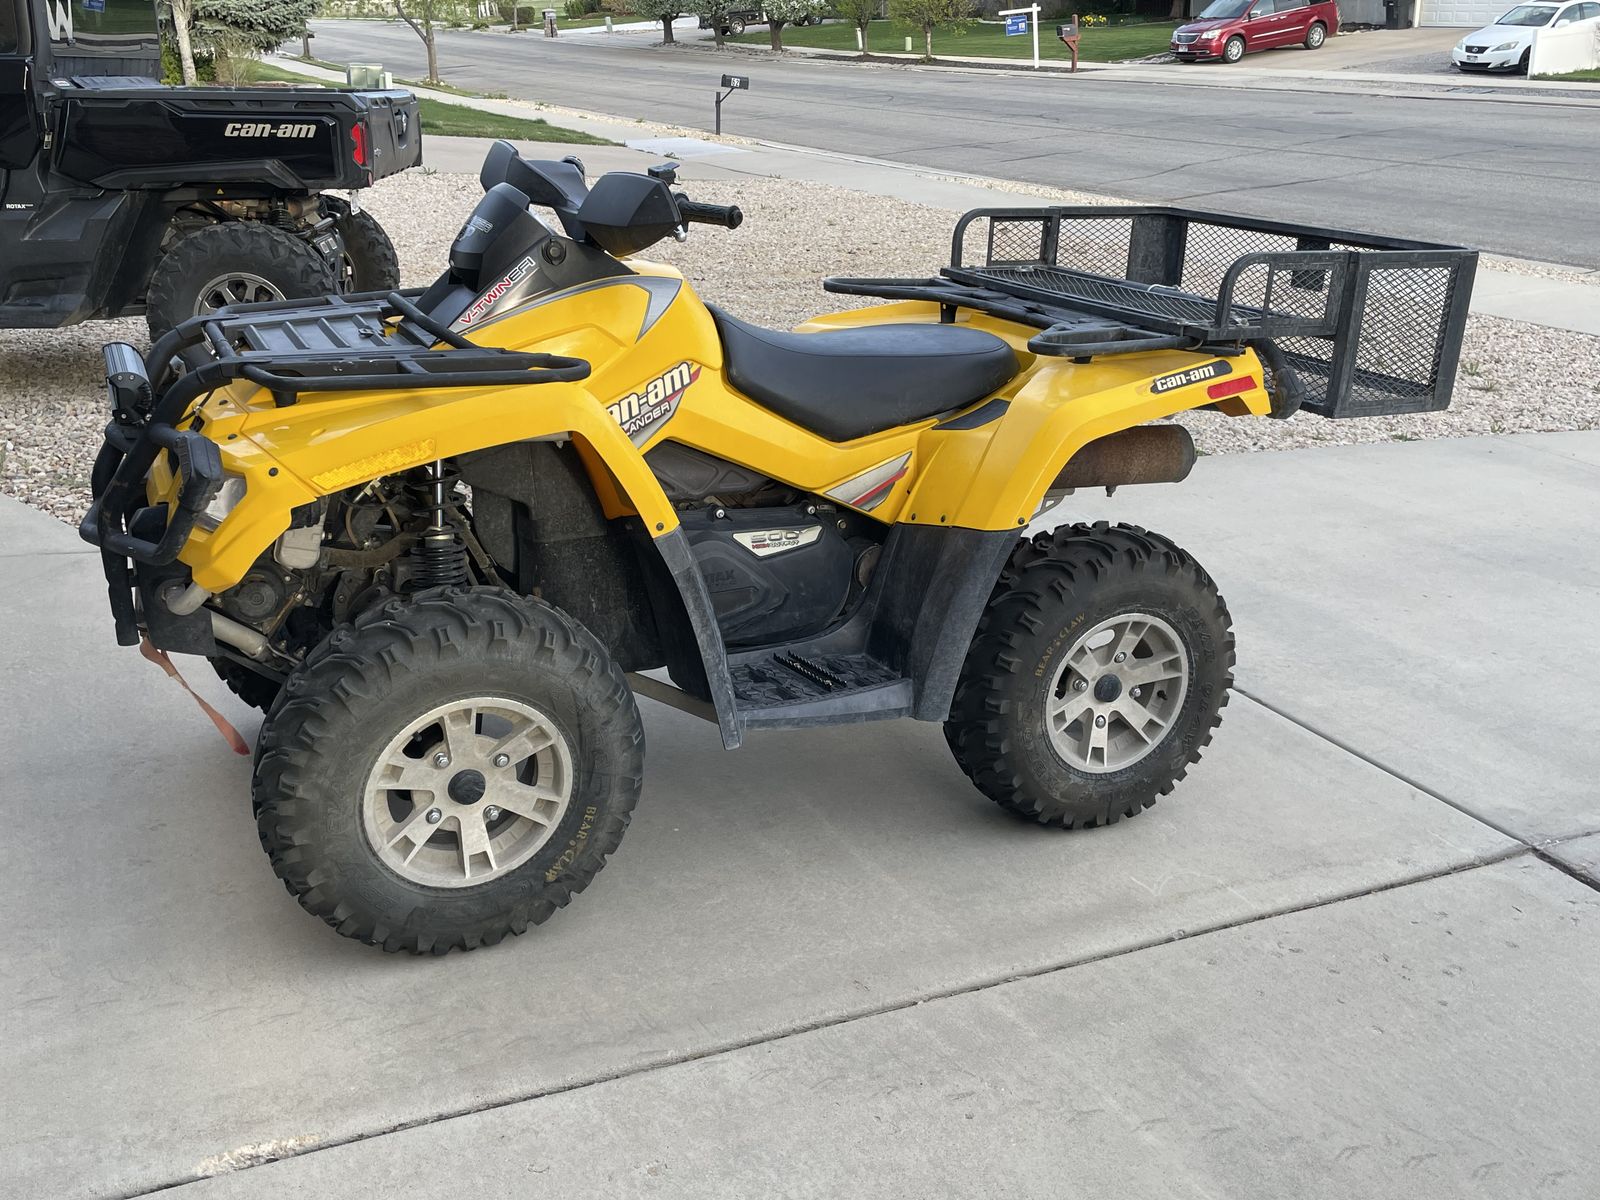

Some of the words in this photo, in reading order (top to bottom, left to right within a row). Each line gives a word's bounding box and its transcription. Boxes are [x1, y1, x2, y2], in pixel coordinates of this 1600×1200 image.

[224, 123, 317, 138] can-am
[605, 361, 692, 426] an-am
[1155, 365, 1215, 391] can-am
[626, 401, 671, 436] ANDER
[750, 530, 800, 544] 500
[1034, 645, 1055, 677] BEAR
[1059, 612, 1085, 638] CLAW
[576, 806, 597, 839] BEAR
